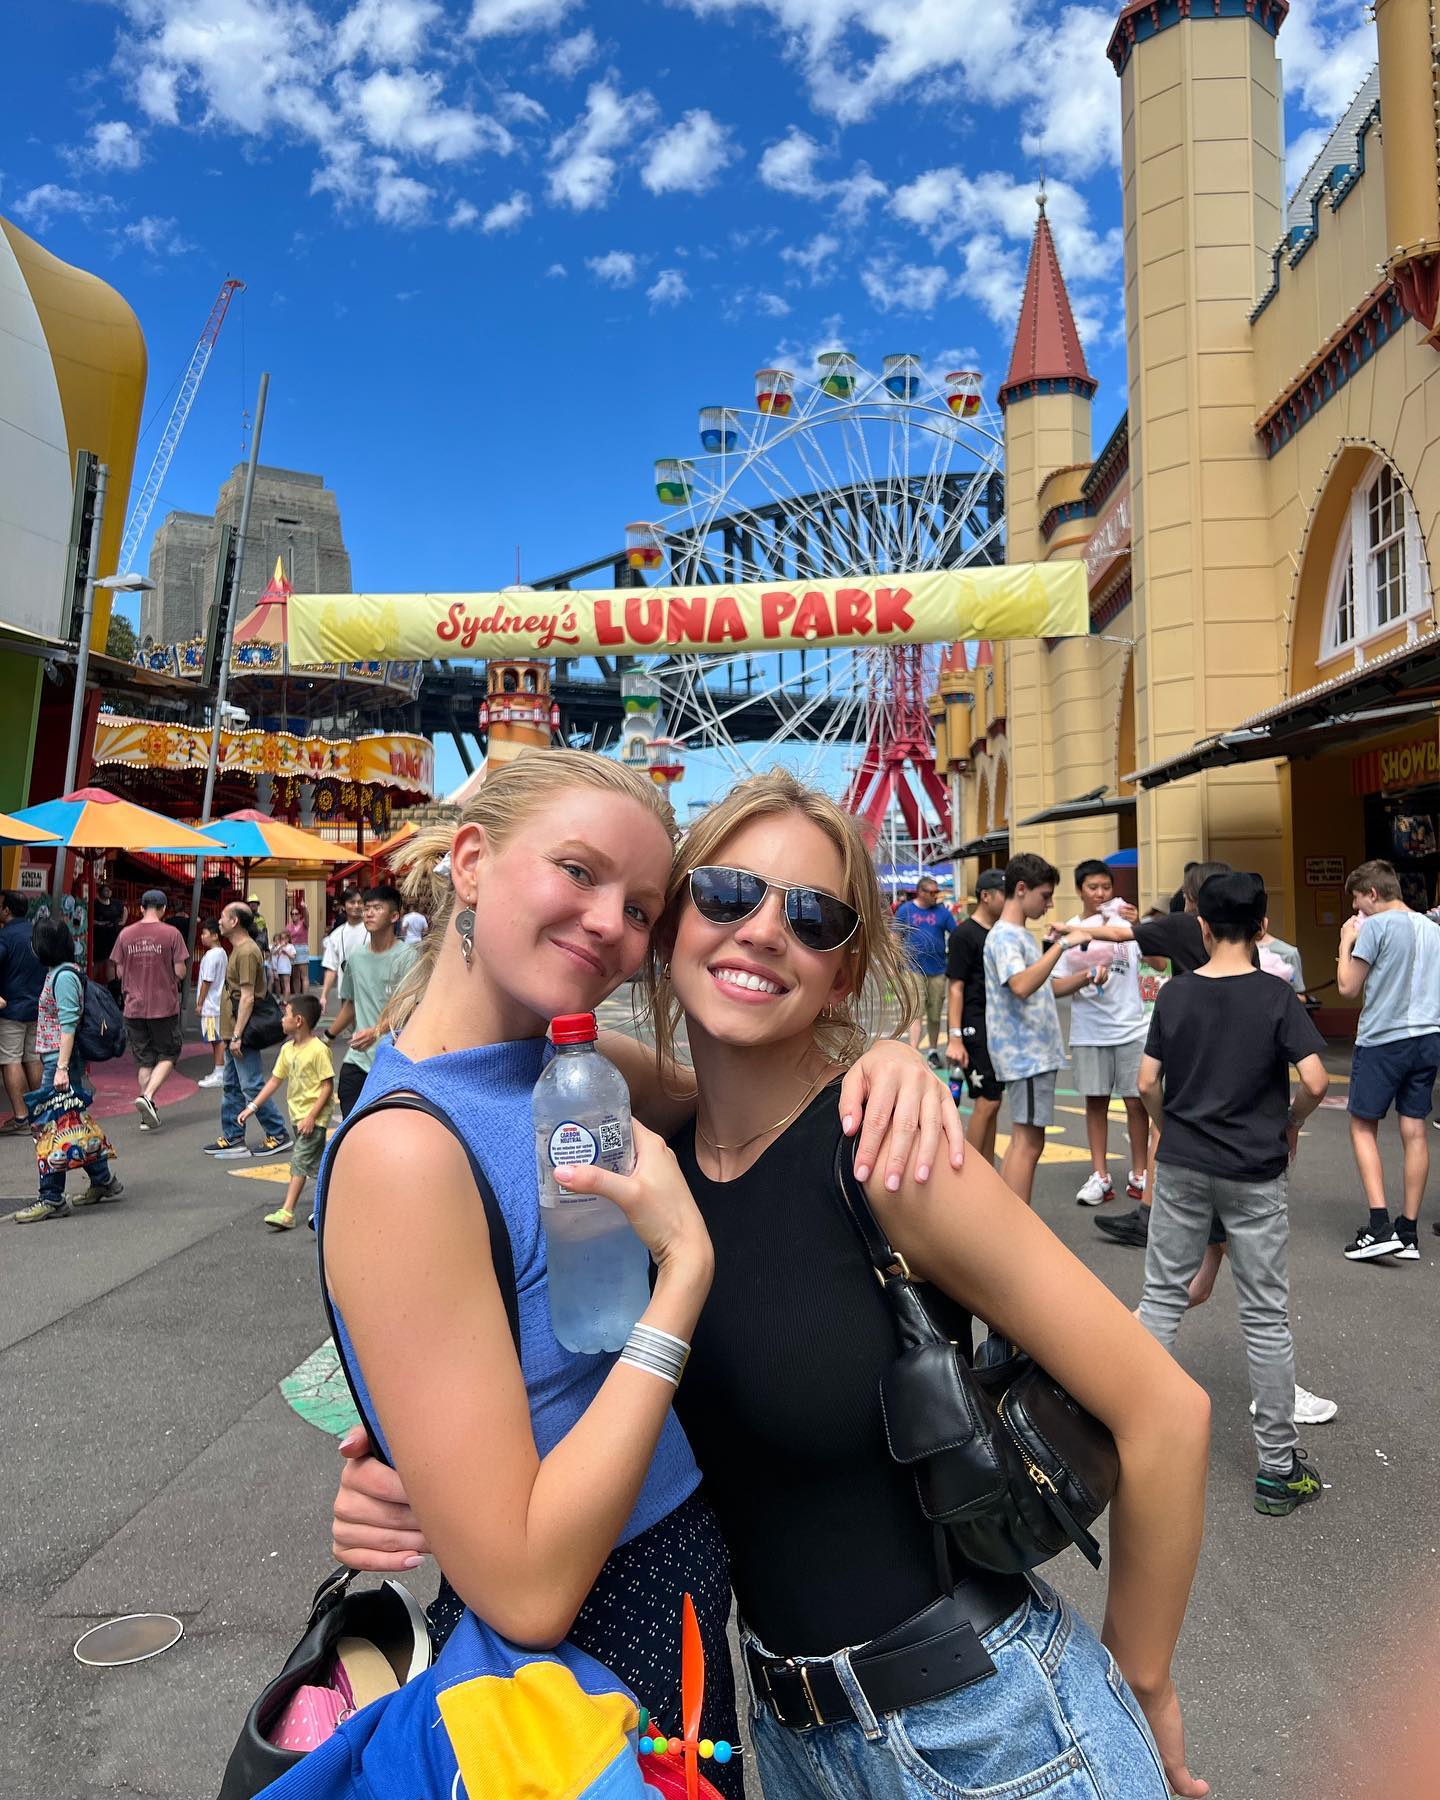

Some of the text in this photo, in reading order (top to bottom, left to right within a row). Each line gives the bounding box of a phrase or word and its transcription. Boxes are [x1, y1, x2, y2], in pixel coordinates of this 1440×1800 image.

[436, 586, 916, 649] Sydney's LUNA PARK
